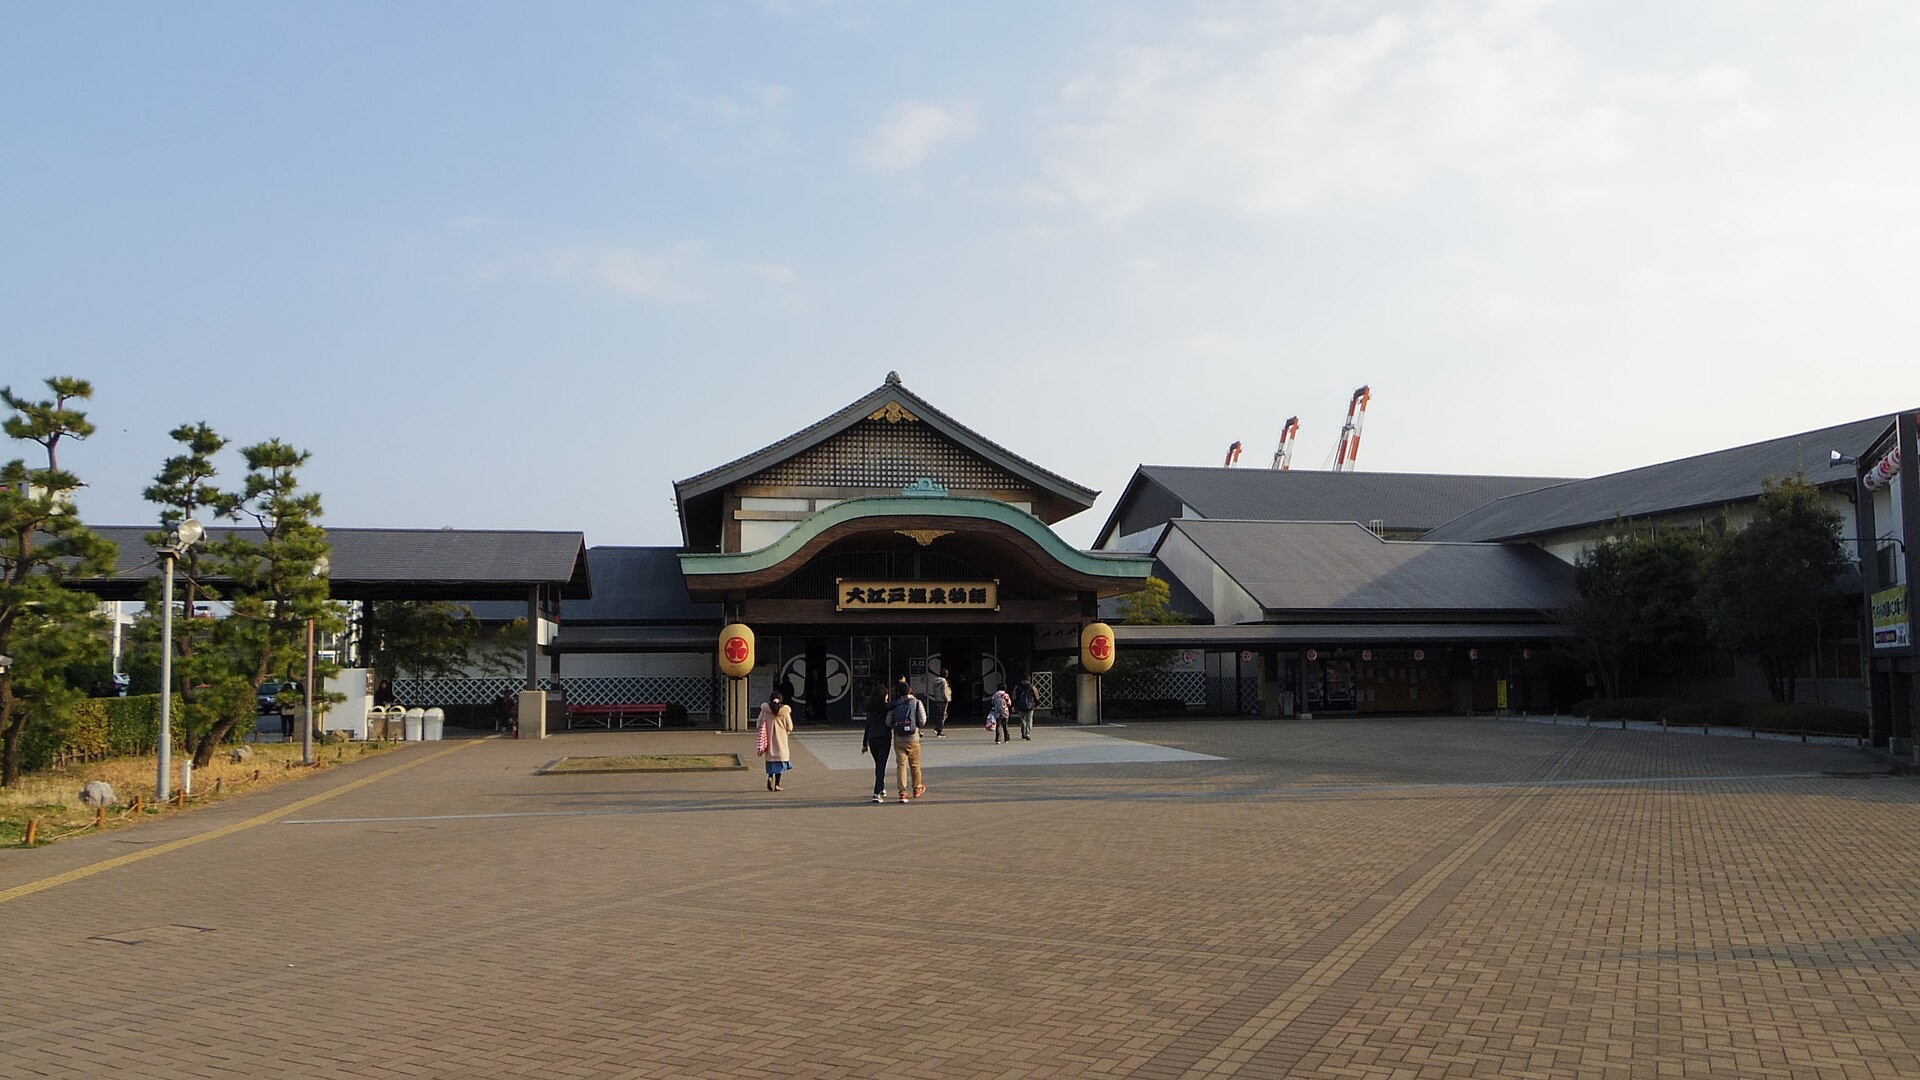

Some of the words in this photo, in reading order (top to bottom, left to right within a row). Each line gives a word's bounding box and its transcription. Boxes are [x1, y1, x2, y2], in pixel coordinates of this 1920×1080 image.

[846, 587, 987, 604] 大江戸温泉物語
[911, 659, 925, 667] 入口
